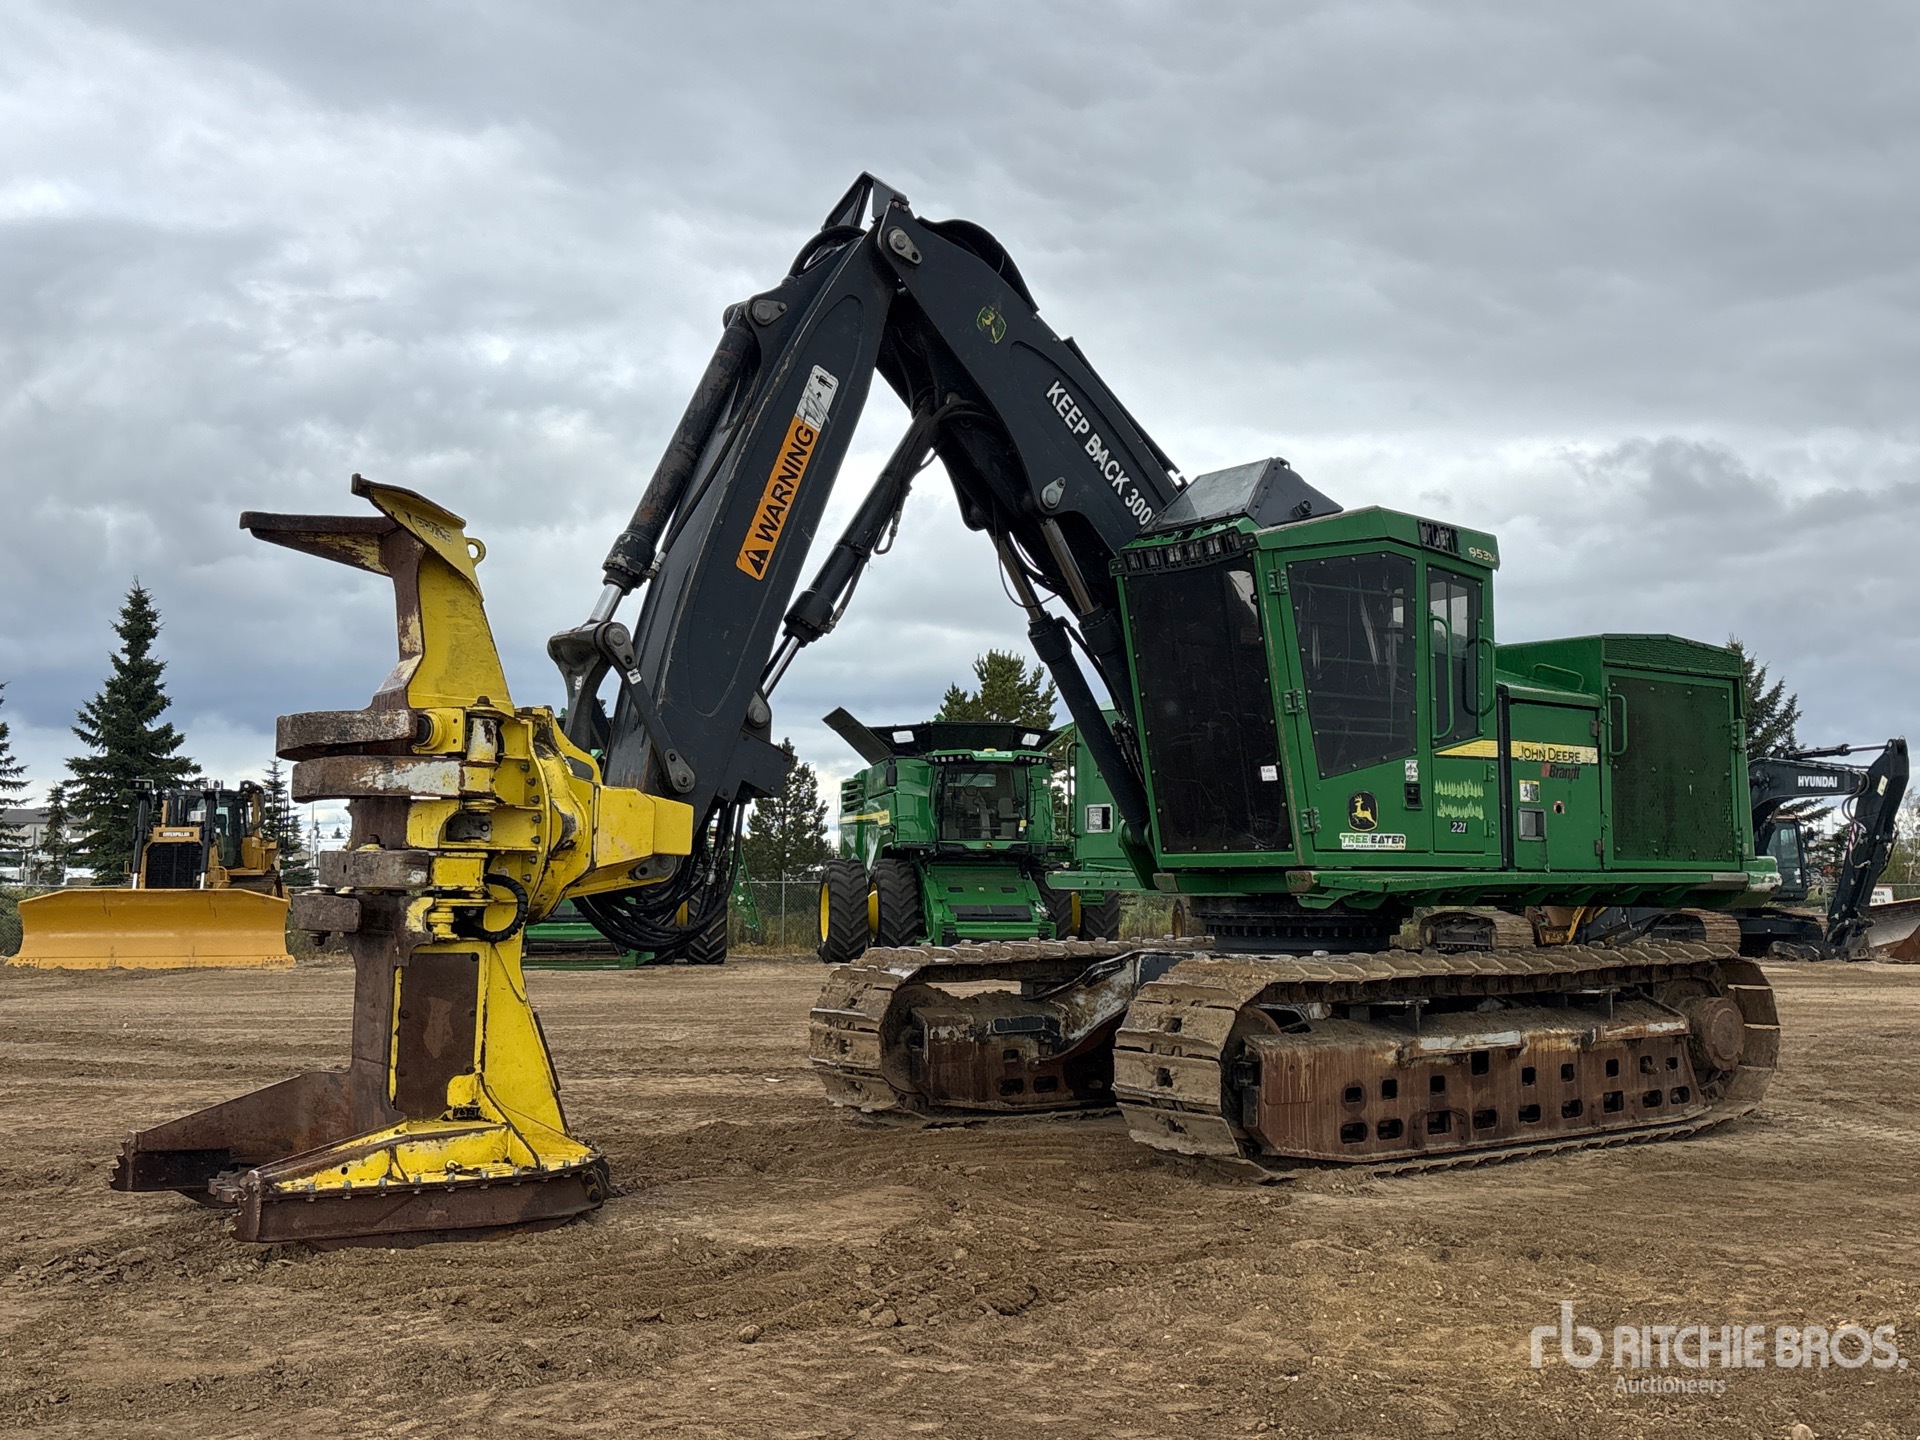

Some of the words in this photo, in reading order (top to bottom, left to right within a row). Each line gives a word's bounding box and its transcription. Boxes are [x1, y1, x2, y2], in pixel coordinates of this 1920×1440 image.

[1046, 381, 1090, 434] KEEP
[1084, 433, 1130, 496] BACK
[755, 425, 813, 542] WARNING
[1519, 745, 1546, 759] JOHN
[1548, 747, 1581, 763] DEERE
[1798, 776, 1837, 787] HYUNDAI
[1451, 822, 1467, 833] 221
[1341, 834, 1369, 844] TREE
[1371, 835, 1405, 844] EATER
